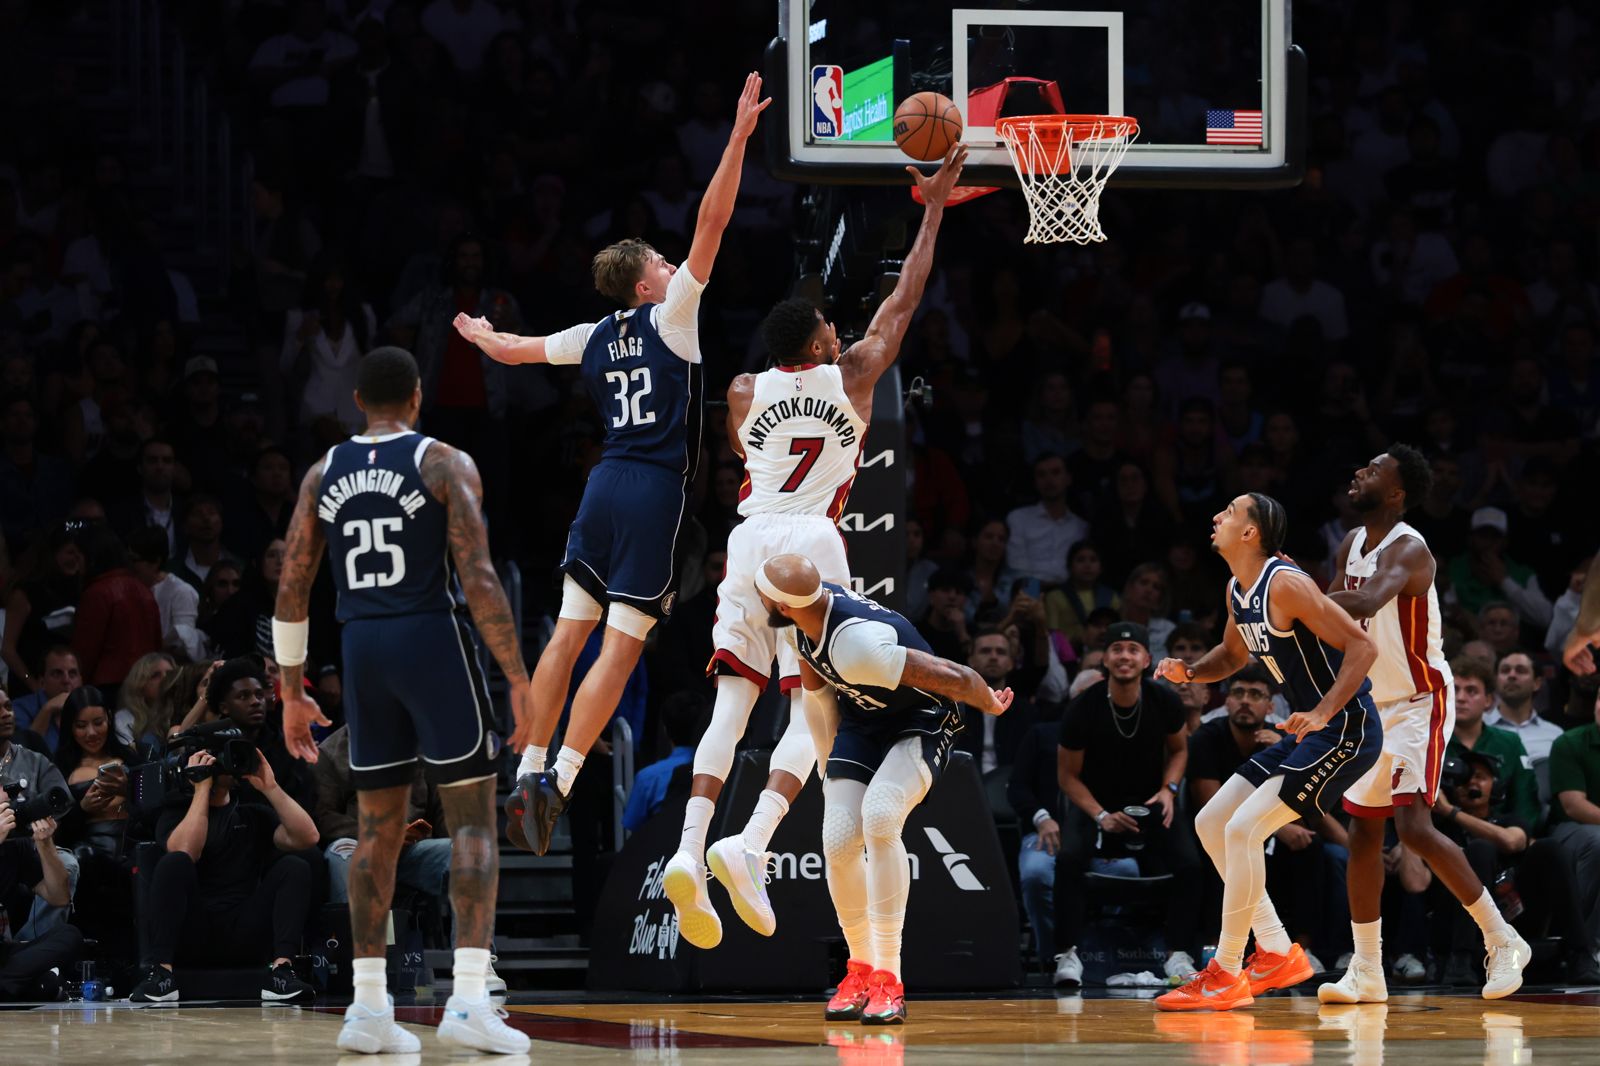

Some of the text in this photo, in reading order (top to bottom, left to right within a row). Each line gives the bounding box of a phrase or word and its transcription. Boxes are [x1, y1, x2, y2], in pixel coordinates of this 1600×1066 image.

[816, 121, 832, 134] NBA
[864, 92, 888, 126] Health
[607, 336, 643, 362] FLAGG
[604, 366, 656, 428] 32
[747, 397, 856, 451] ANTETOKOUNMPO
[778, 436, 825, 492] 7
[318, 468, 427, 524] WASHINGTON JR.
[343, 516, 406, 590] 25
[629, 909, 657, 955] Blue
[1117, 948, 1168, 961] Sotheby
